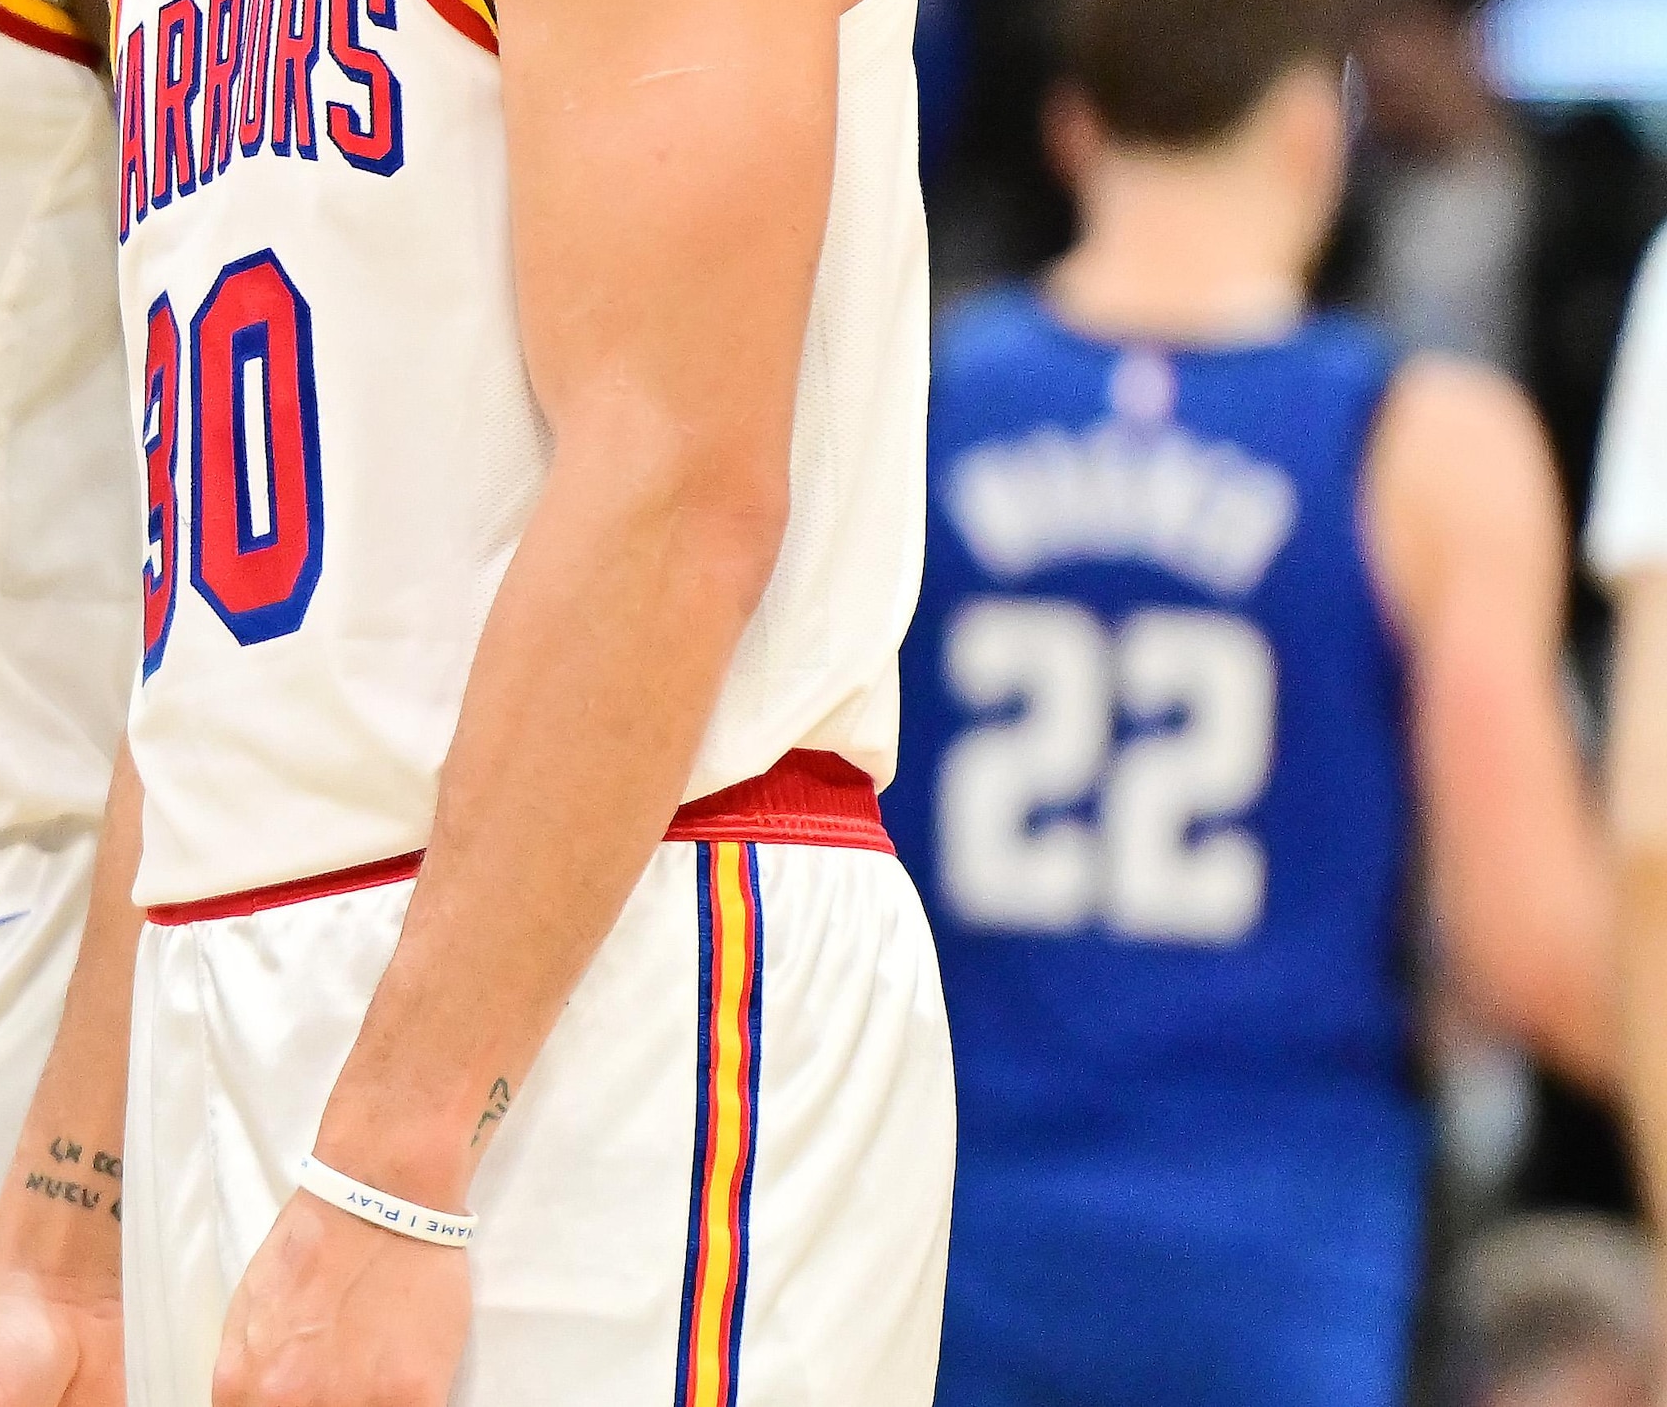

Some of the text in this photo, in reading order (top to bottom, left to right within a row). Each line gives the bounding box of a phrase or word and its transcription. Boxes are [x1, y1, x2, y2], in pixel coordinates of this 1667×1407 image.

[937, 596, 1276, 946] 22
[347, 1192, 400, 1221] PLAY
[410, 1215, 417, 1227] I
